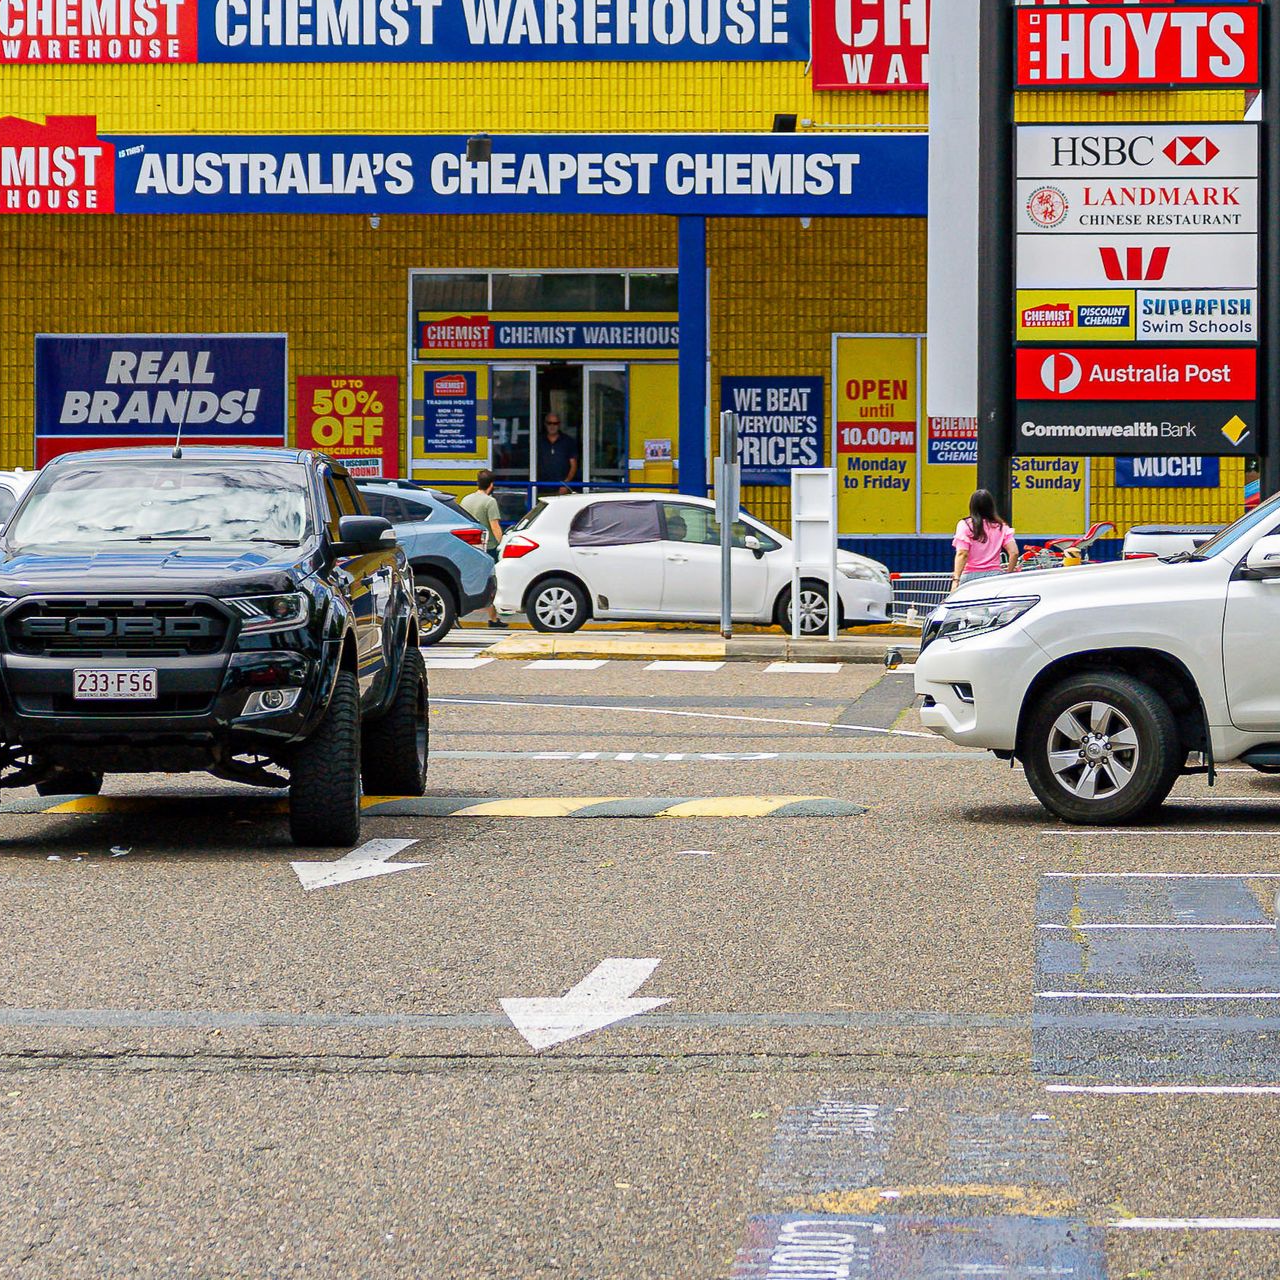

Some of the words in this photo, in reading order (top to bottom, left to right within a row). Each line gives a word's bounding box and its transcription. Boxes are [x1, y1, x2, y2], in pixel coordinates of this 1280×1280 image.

[2, 38, 180, 59] WAREHOUSE
[1046, 11, 1246, 79] HOYTS
[1051, 135, 1154, 167] HSBC
[135, 152, 414, 195] AUSTRALIA'S
[430, 152, 658, 195] CHEAPEST
[665, 152, 860, 195] CHEMIST
[1083, 187, 1240, 206] LANDMARK
[1079, 214, 1141, 225] CHINESE
[1146, 214, 1241, 225] RESTAURANT
[1024, 310, 1071, 322] CHEMIST
[1080, 306, 1127, 316] DISCOUNT
[1084, 316, 1124, 326] CHEMIST
[1142, 320, 1183, 333] Swim
[1189, 320, 1252, 333] Schools
[427, 326, 490, 340] CHEMIST
[499, 326, 576, 344] CHEMIST
[105, 351, 215, 384] REAL
[1089, 364, 1179, 382] Australia
[1185, 364, 1231, 382] Post
[331, 380, 347, 388] UP
[348, 380, 363, 388] TO
[845, 379, 908, 401] OPEN
[59, 388, 261, 424] BRANDS!
[311, 388, 384, 415] 50%
[733, 388, 761, 412] WE
[766, 388, 811, 412] BEAT
[859, 403, 894, 418] until
[311, 416, 384, 446] OFF
[840, 427, 914, 446] 10.00PM
[1021, 421, 1158, 437] Commonwealth
[1160, 421, 1197, 437] Bank
[847, 457, 907, 475] Monday
[1011, 458, 1079, 474] Saturday
[1133, 456, 1202, 477] MUCH!
[844, 476, 859, 489] to
[863, 475, 910, 492] Friday
[1011, 476, 1020, 488] &
[1026, 475, 1081, 491] Sunday
[22, 617, 210, 637] FORD
